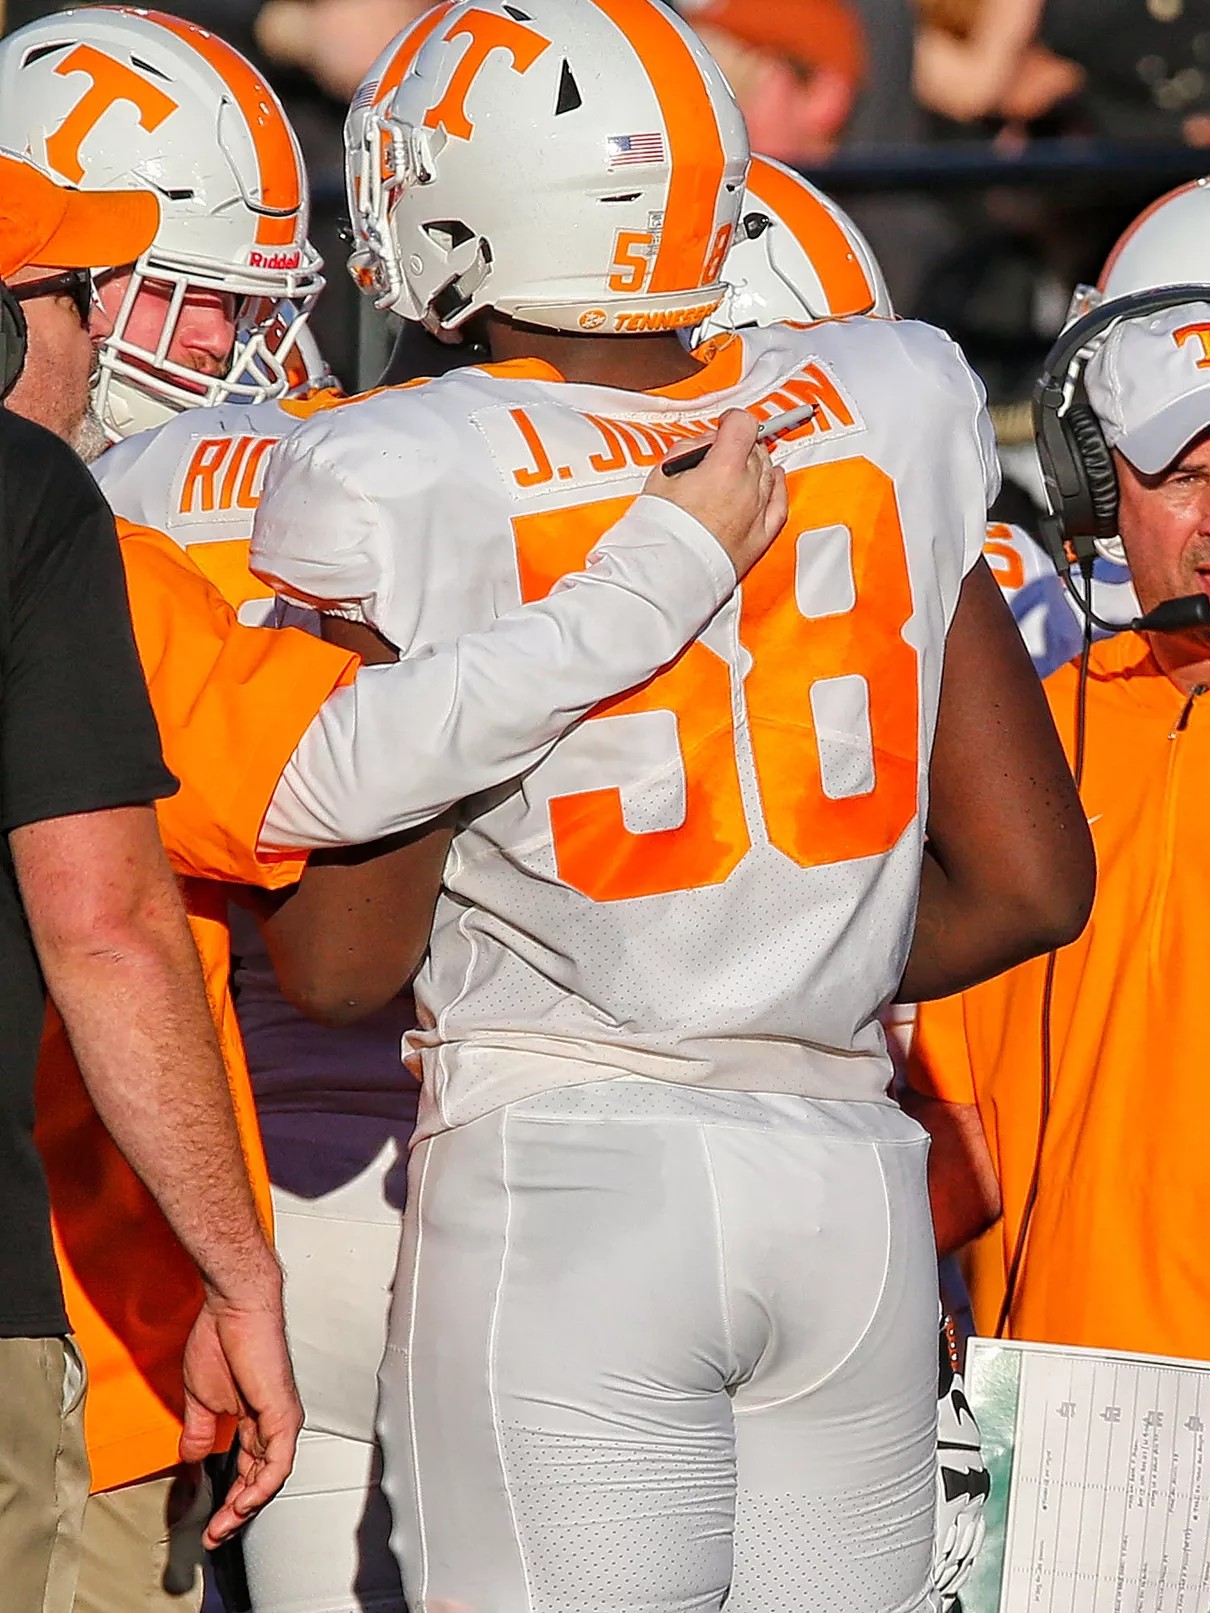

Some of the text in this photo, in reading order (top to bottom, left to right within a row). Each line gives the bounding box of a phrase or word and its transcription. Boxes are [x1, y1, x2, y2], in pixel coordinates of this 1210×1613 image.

[45, 43, 180, 184] T
[423, 8, 552, 141] T
[608, 230, 653, 293] 5
[509, 408, 573, 488] J.
